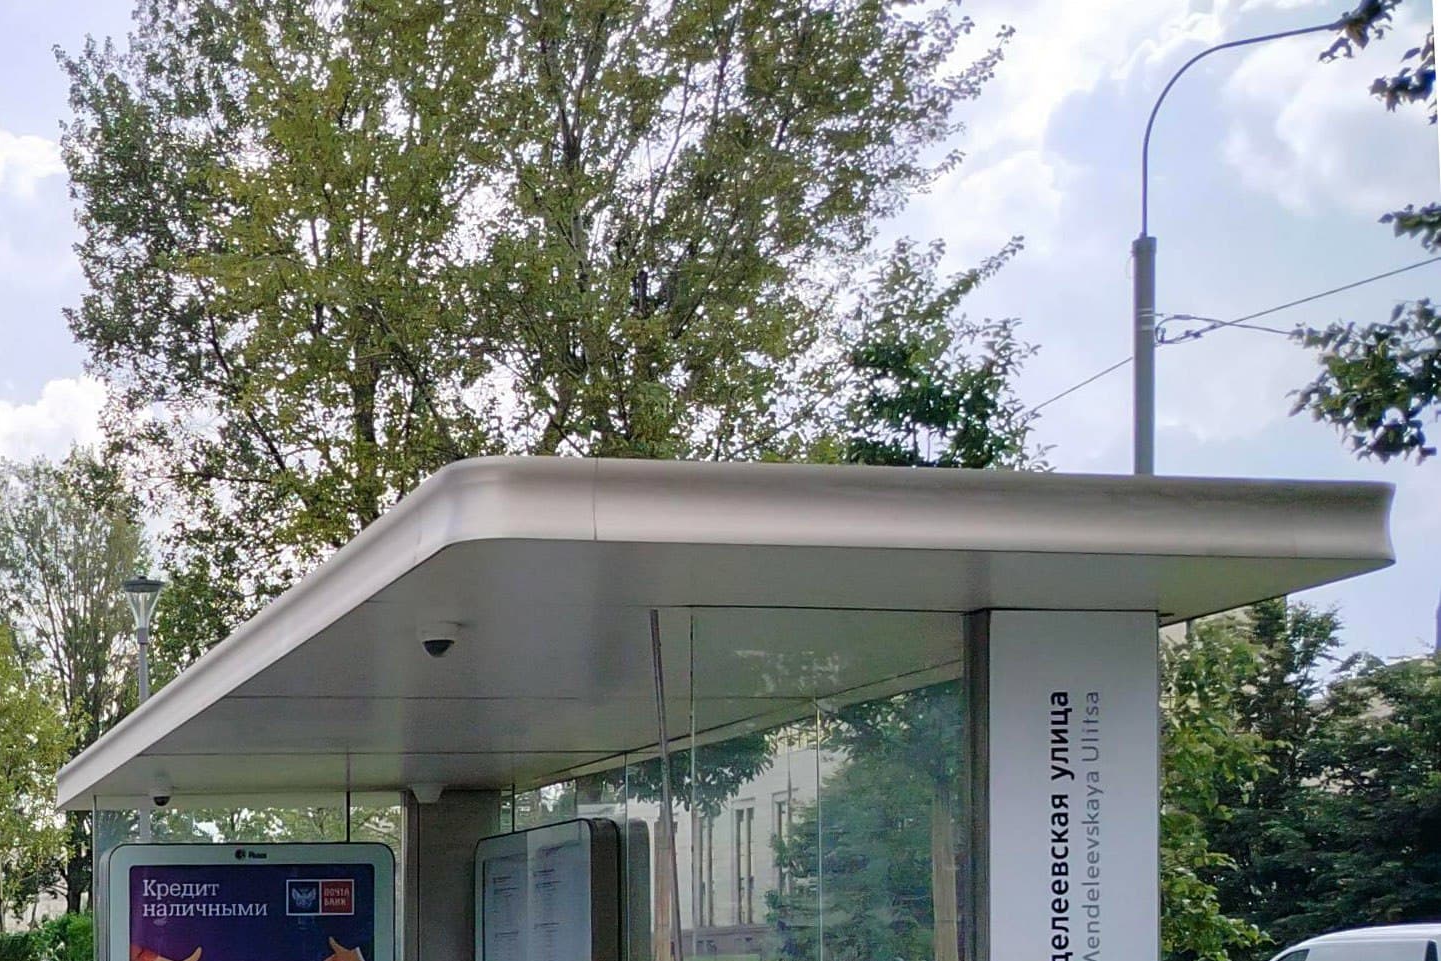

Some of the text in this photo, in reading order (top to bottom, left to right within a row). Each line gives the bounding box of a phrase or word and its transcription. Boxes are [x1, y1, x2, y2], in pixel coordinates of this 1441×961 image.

[1049, 690, 1075, 781] улица
[1081, 691, 1100, 762] Ulitsa
[142, 879, 220, 900] Кредит
[142, 902, 268, 917] наличными
